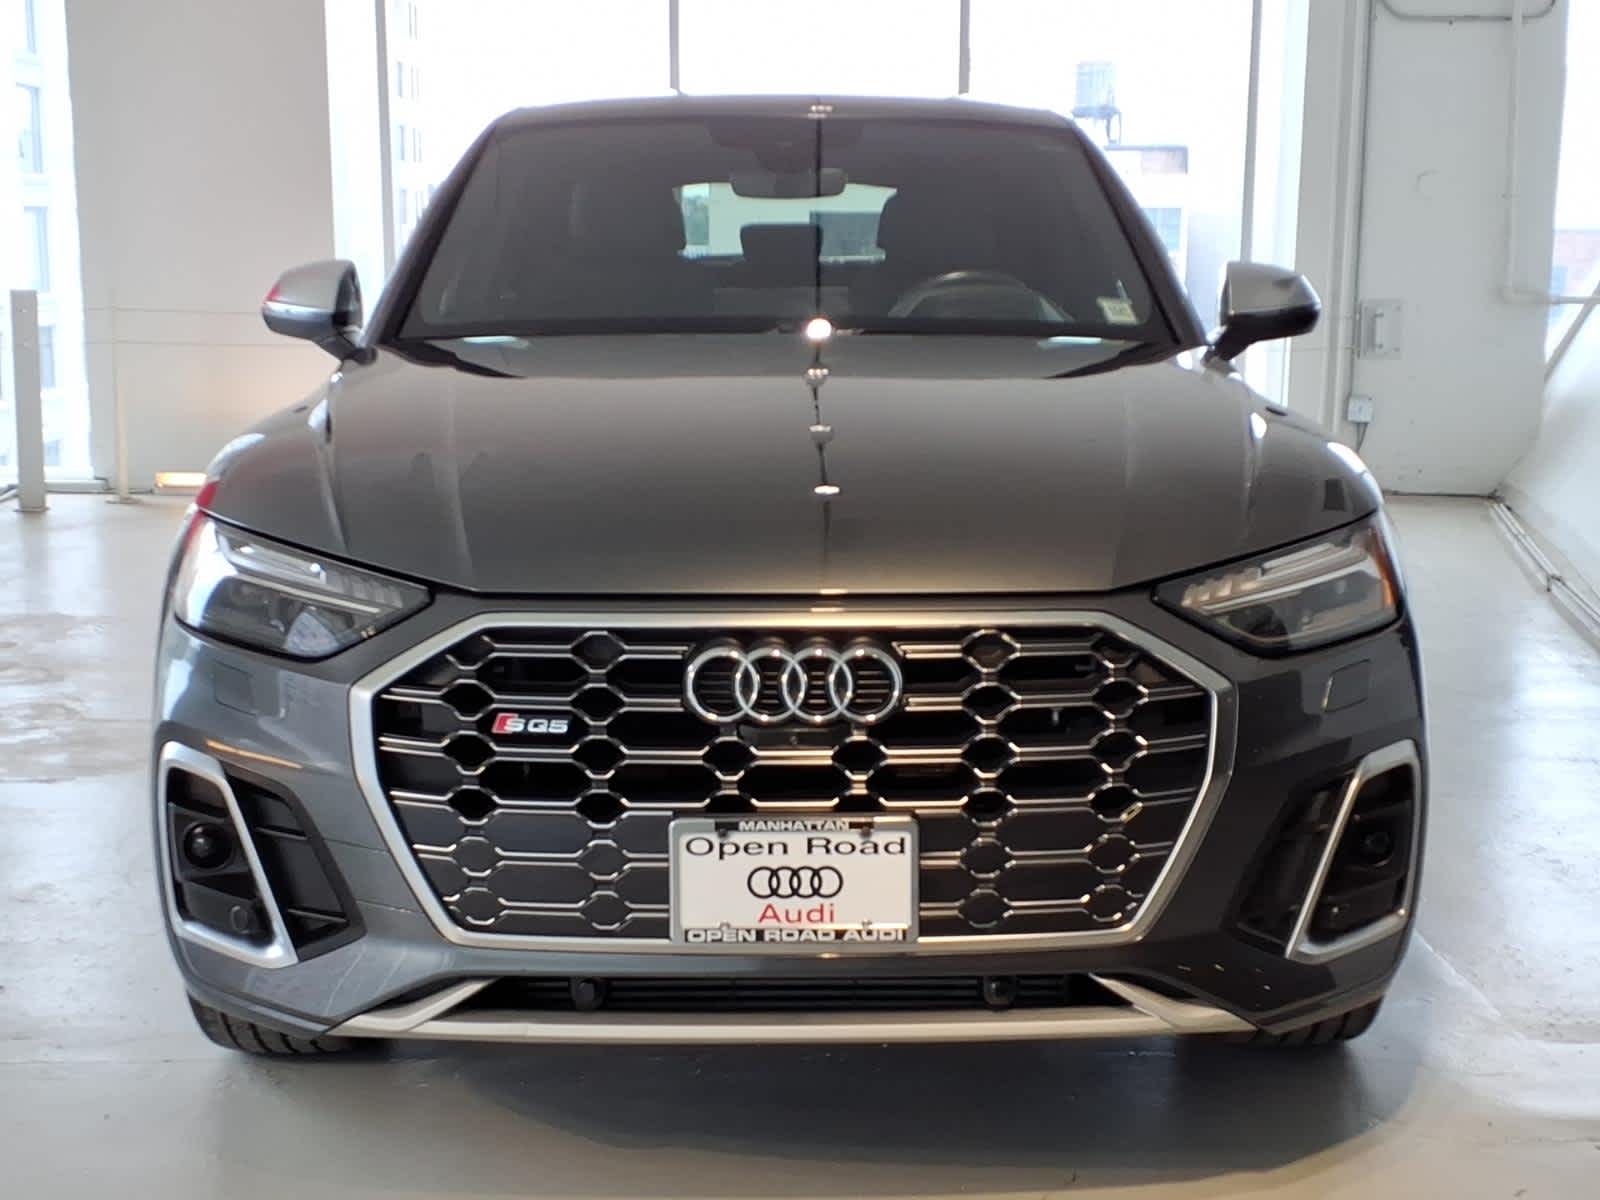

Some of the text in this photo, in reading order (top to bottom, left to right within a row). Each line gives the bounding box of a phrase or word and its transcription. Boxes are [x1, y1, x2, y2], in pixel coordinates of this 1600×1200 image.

[501, 717, 569, 733] SQ5
[738, 820, 851, 832] MANHATTAN
[686, 837, 906, 860] Open Road
[758, 903, 836, 924] Audi
[687, 928, 904, 943] OPEN ROAD AUDI
